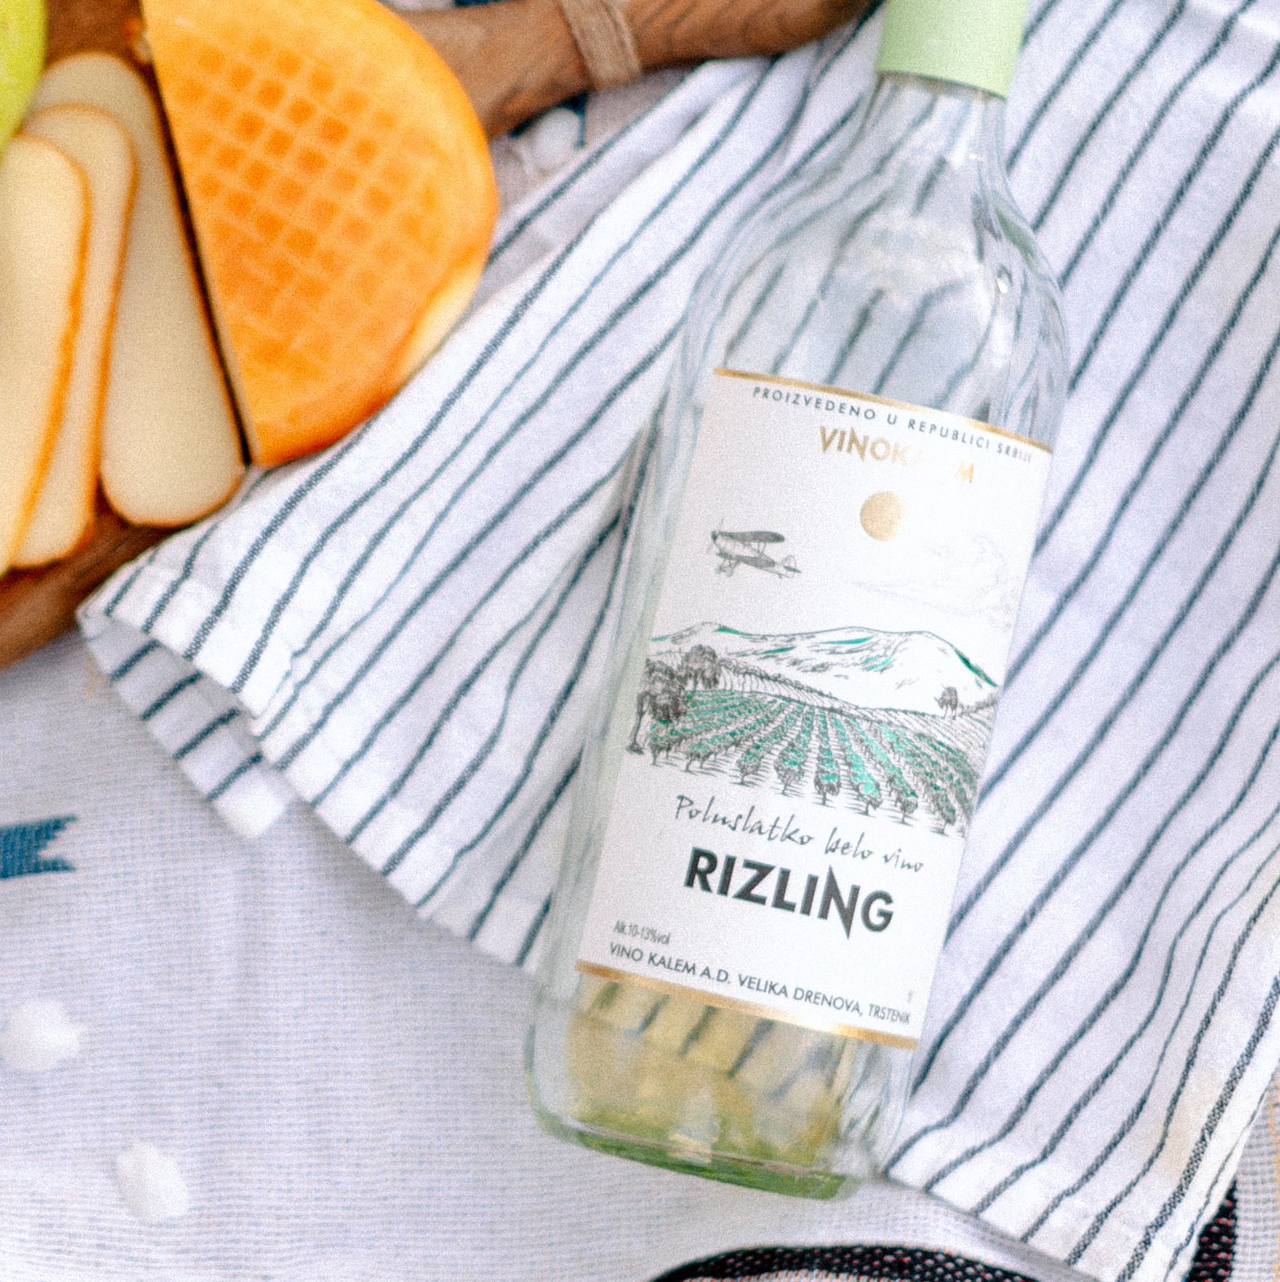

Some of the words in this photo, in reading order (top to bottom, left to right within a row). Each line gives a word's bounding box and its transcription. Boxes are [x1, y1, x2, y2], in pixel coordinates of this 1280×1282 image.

[753, 386, 876, 420] PROIZVEDENO
[887, 413, 898, 426] U
[907, 418, 990, 449] REPUBLICI
[676, 794, 816, 846] Poluslatko
[823, 826, 874, 861] belo
[883, 847, 925, 873] vino
[683, 845, 895, 940] RIZLING
[609, 942, 644, 962] VINO
[647, 952, 696, 976] KALEM
[700, 966, 731, 984] A.D.
[738, 973, 789, 998] VELIKA
[792, 986, 863, 1017] DRENOVA,
[869, 1003, 911, 1026] TRSTENIK
